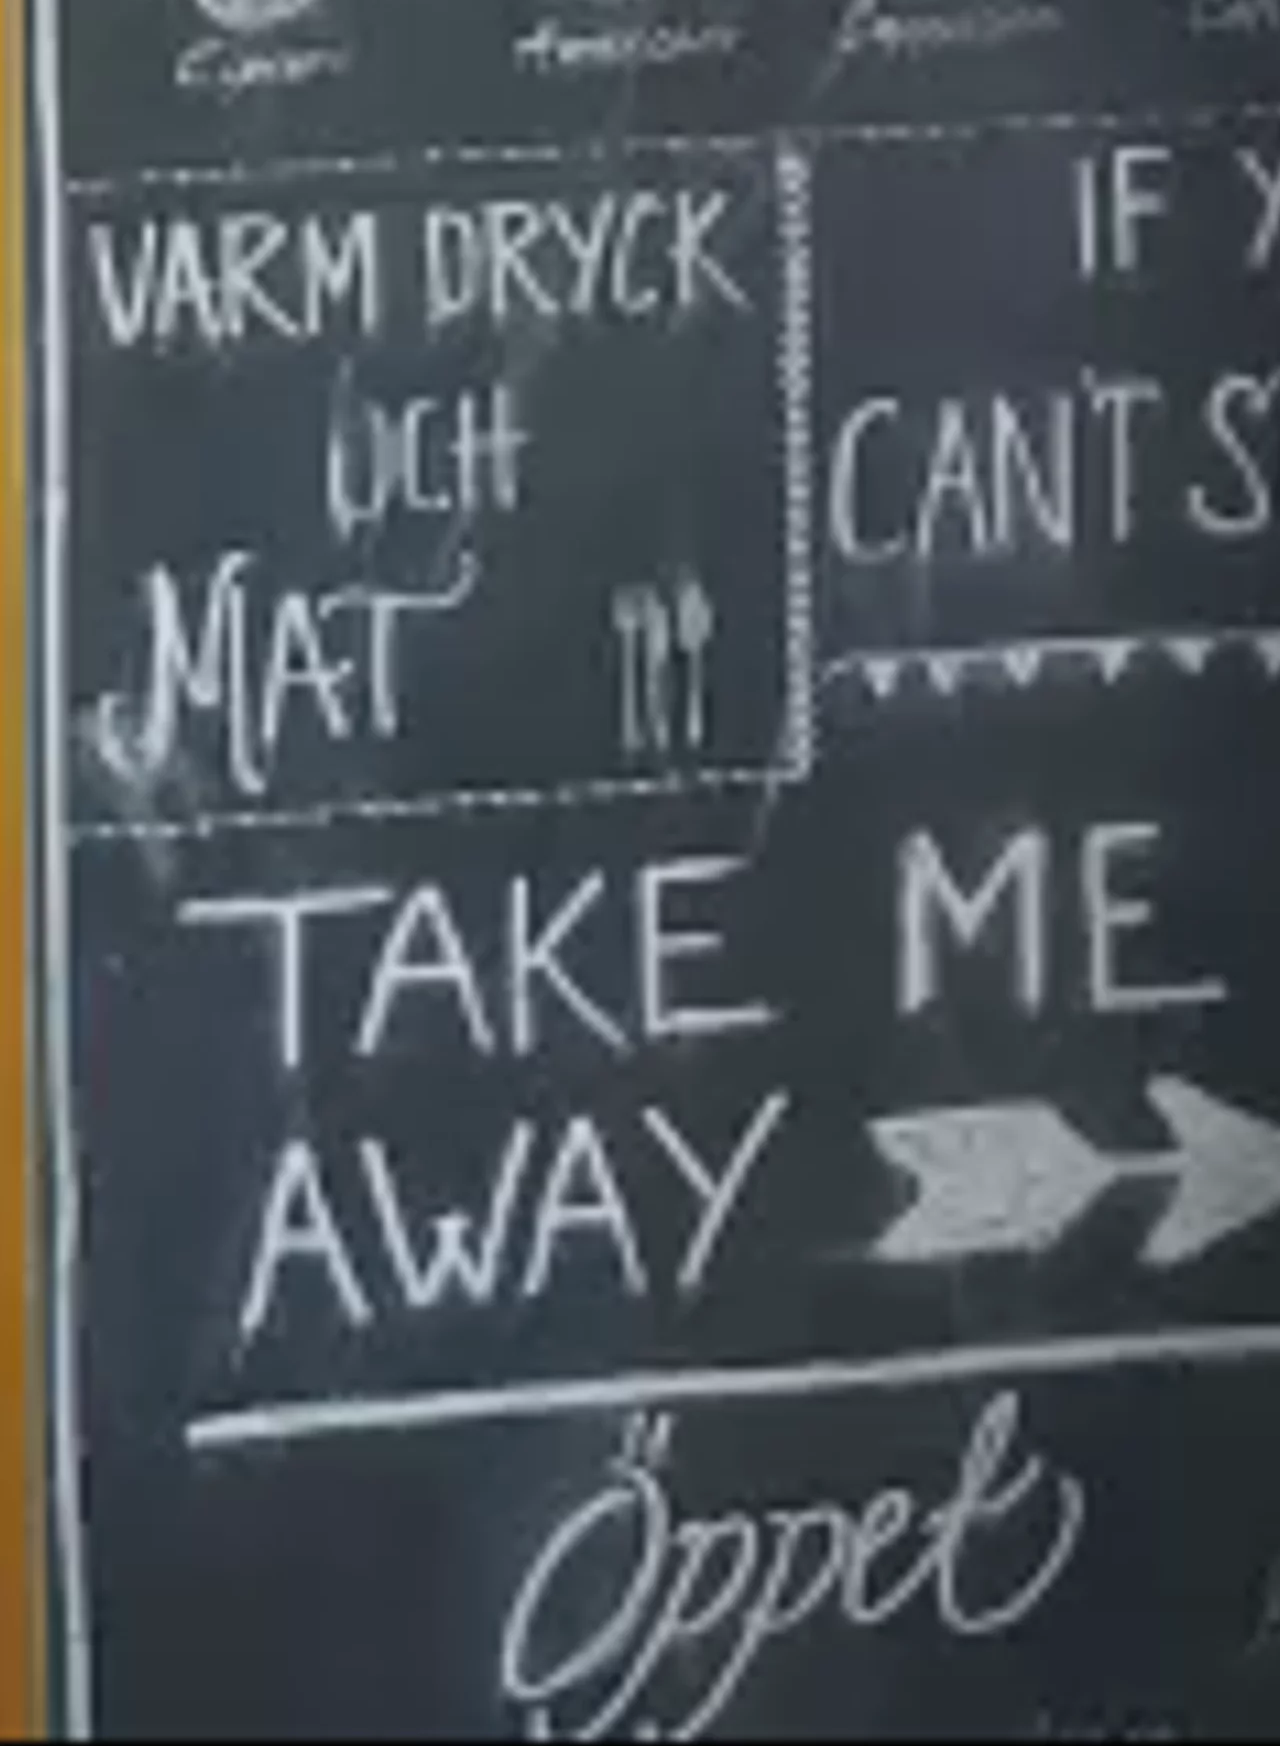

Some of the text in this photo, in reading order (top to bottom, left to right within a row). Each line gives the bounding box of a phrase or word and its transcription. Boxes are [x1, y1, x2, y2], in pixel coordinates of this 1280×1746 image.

[90, 192, 752, 346] VARM DRYCK
[1075, 152, 1172, 278] IF
[86, 552, 478, 796] MAT
[175, 822, 1228, 1068] TAKE ME
[235, 1090, 788, 1334] AWAY
